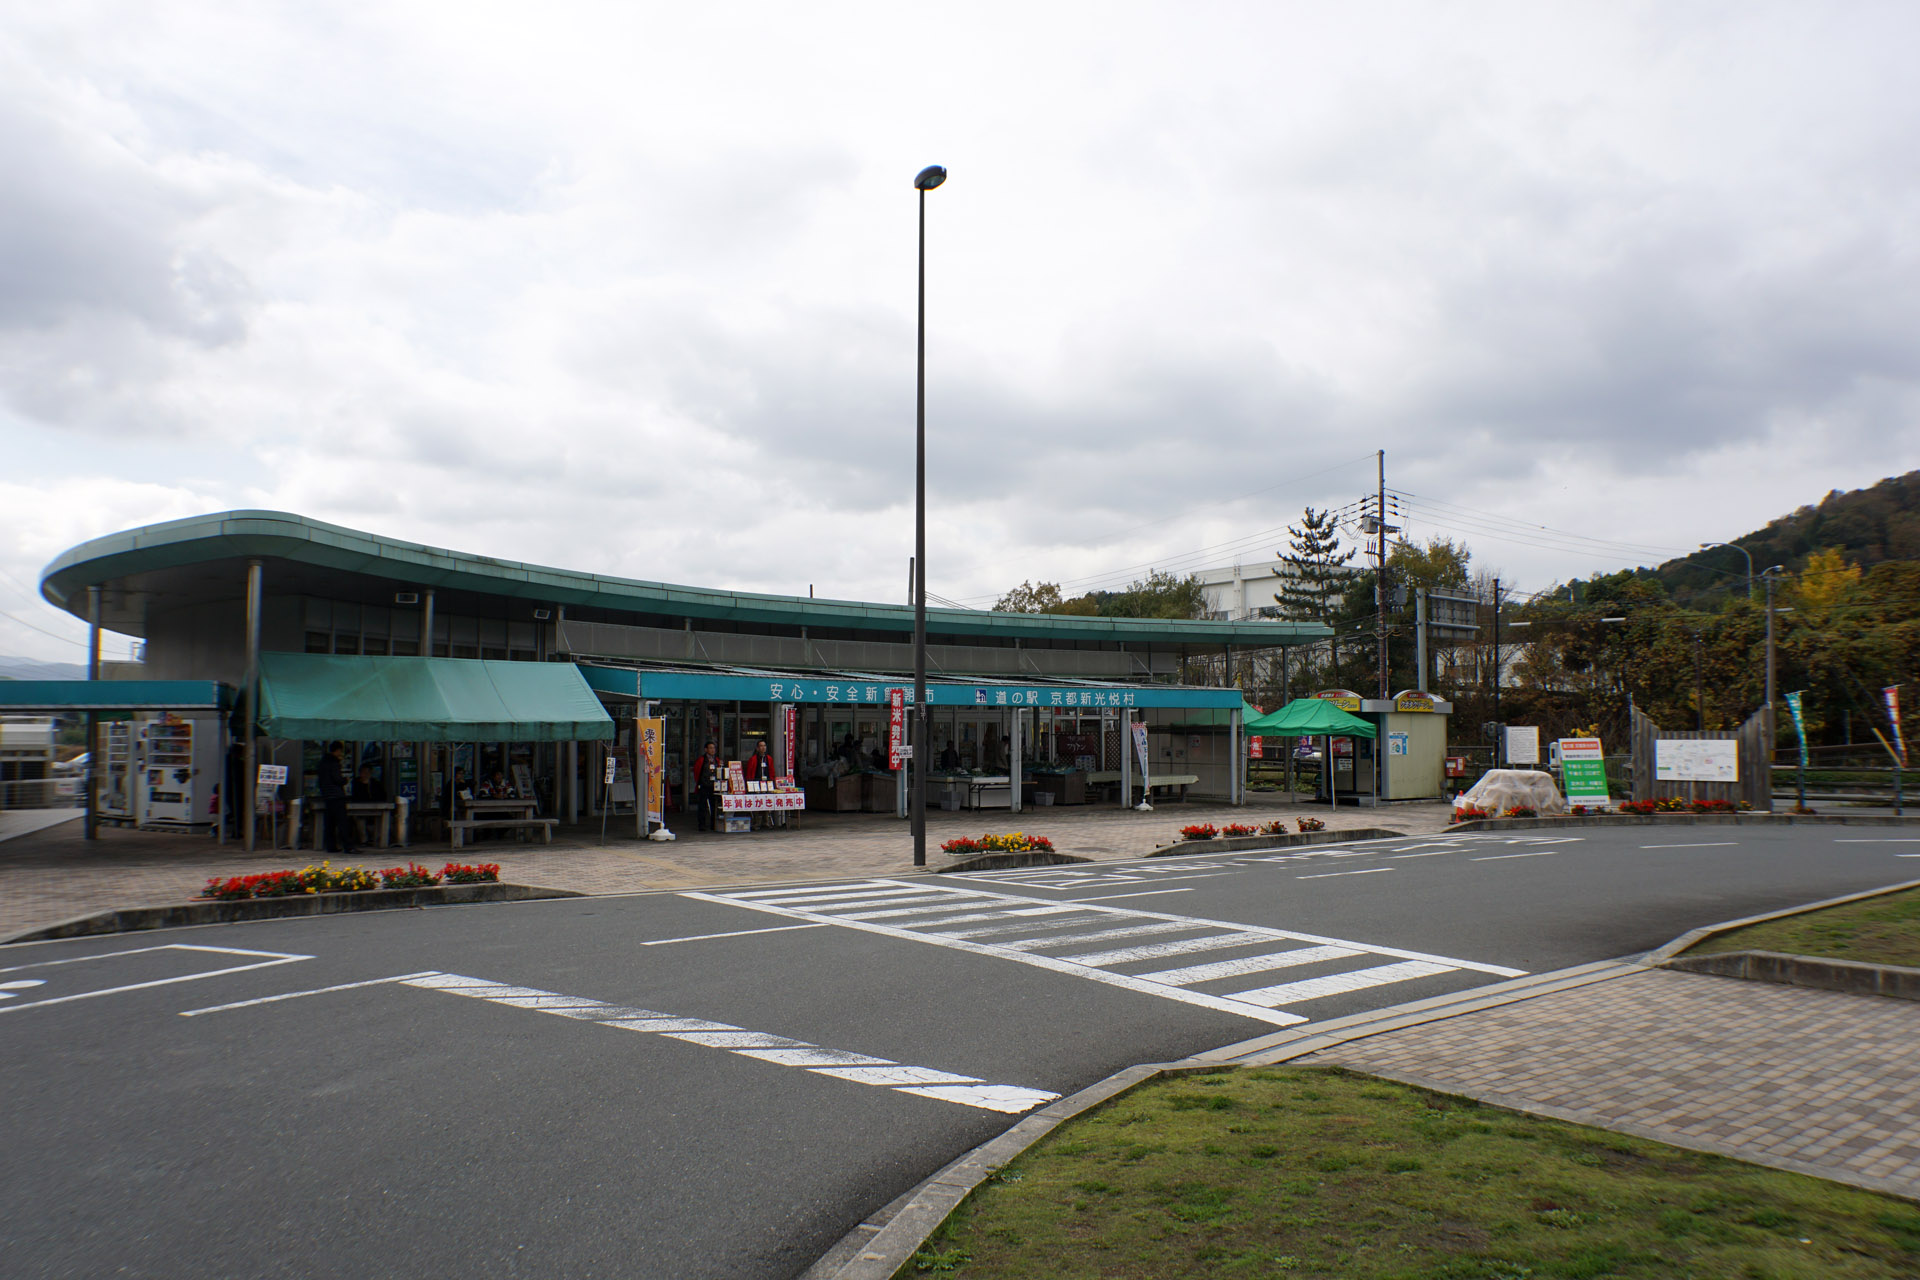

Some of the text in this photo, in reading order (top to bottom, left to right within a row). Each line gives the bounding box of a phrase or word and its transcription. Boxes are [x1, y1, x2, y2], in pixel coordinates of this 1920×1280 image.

[995, 690, 1135, 706] 道の駅 京都新光悦村
[891, 693, 902, 768] 新米発売中
[723, 796, 804, 809] 年賀はがき発売中
